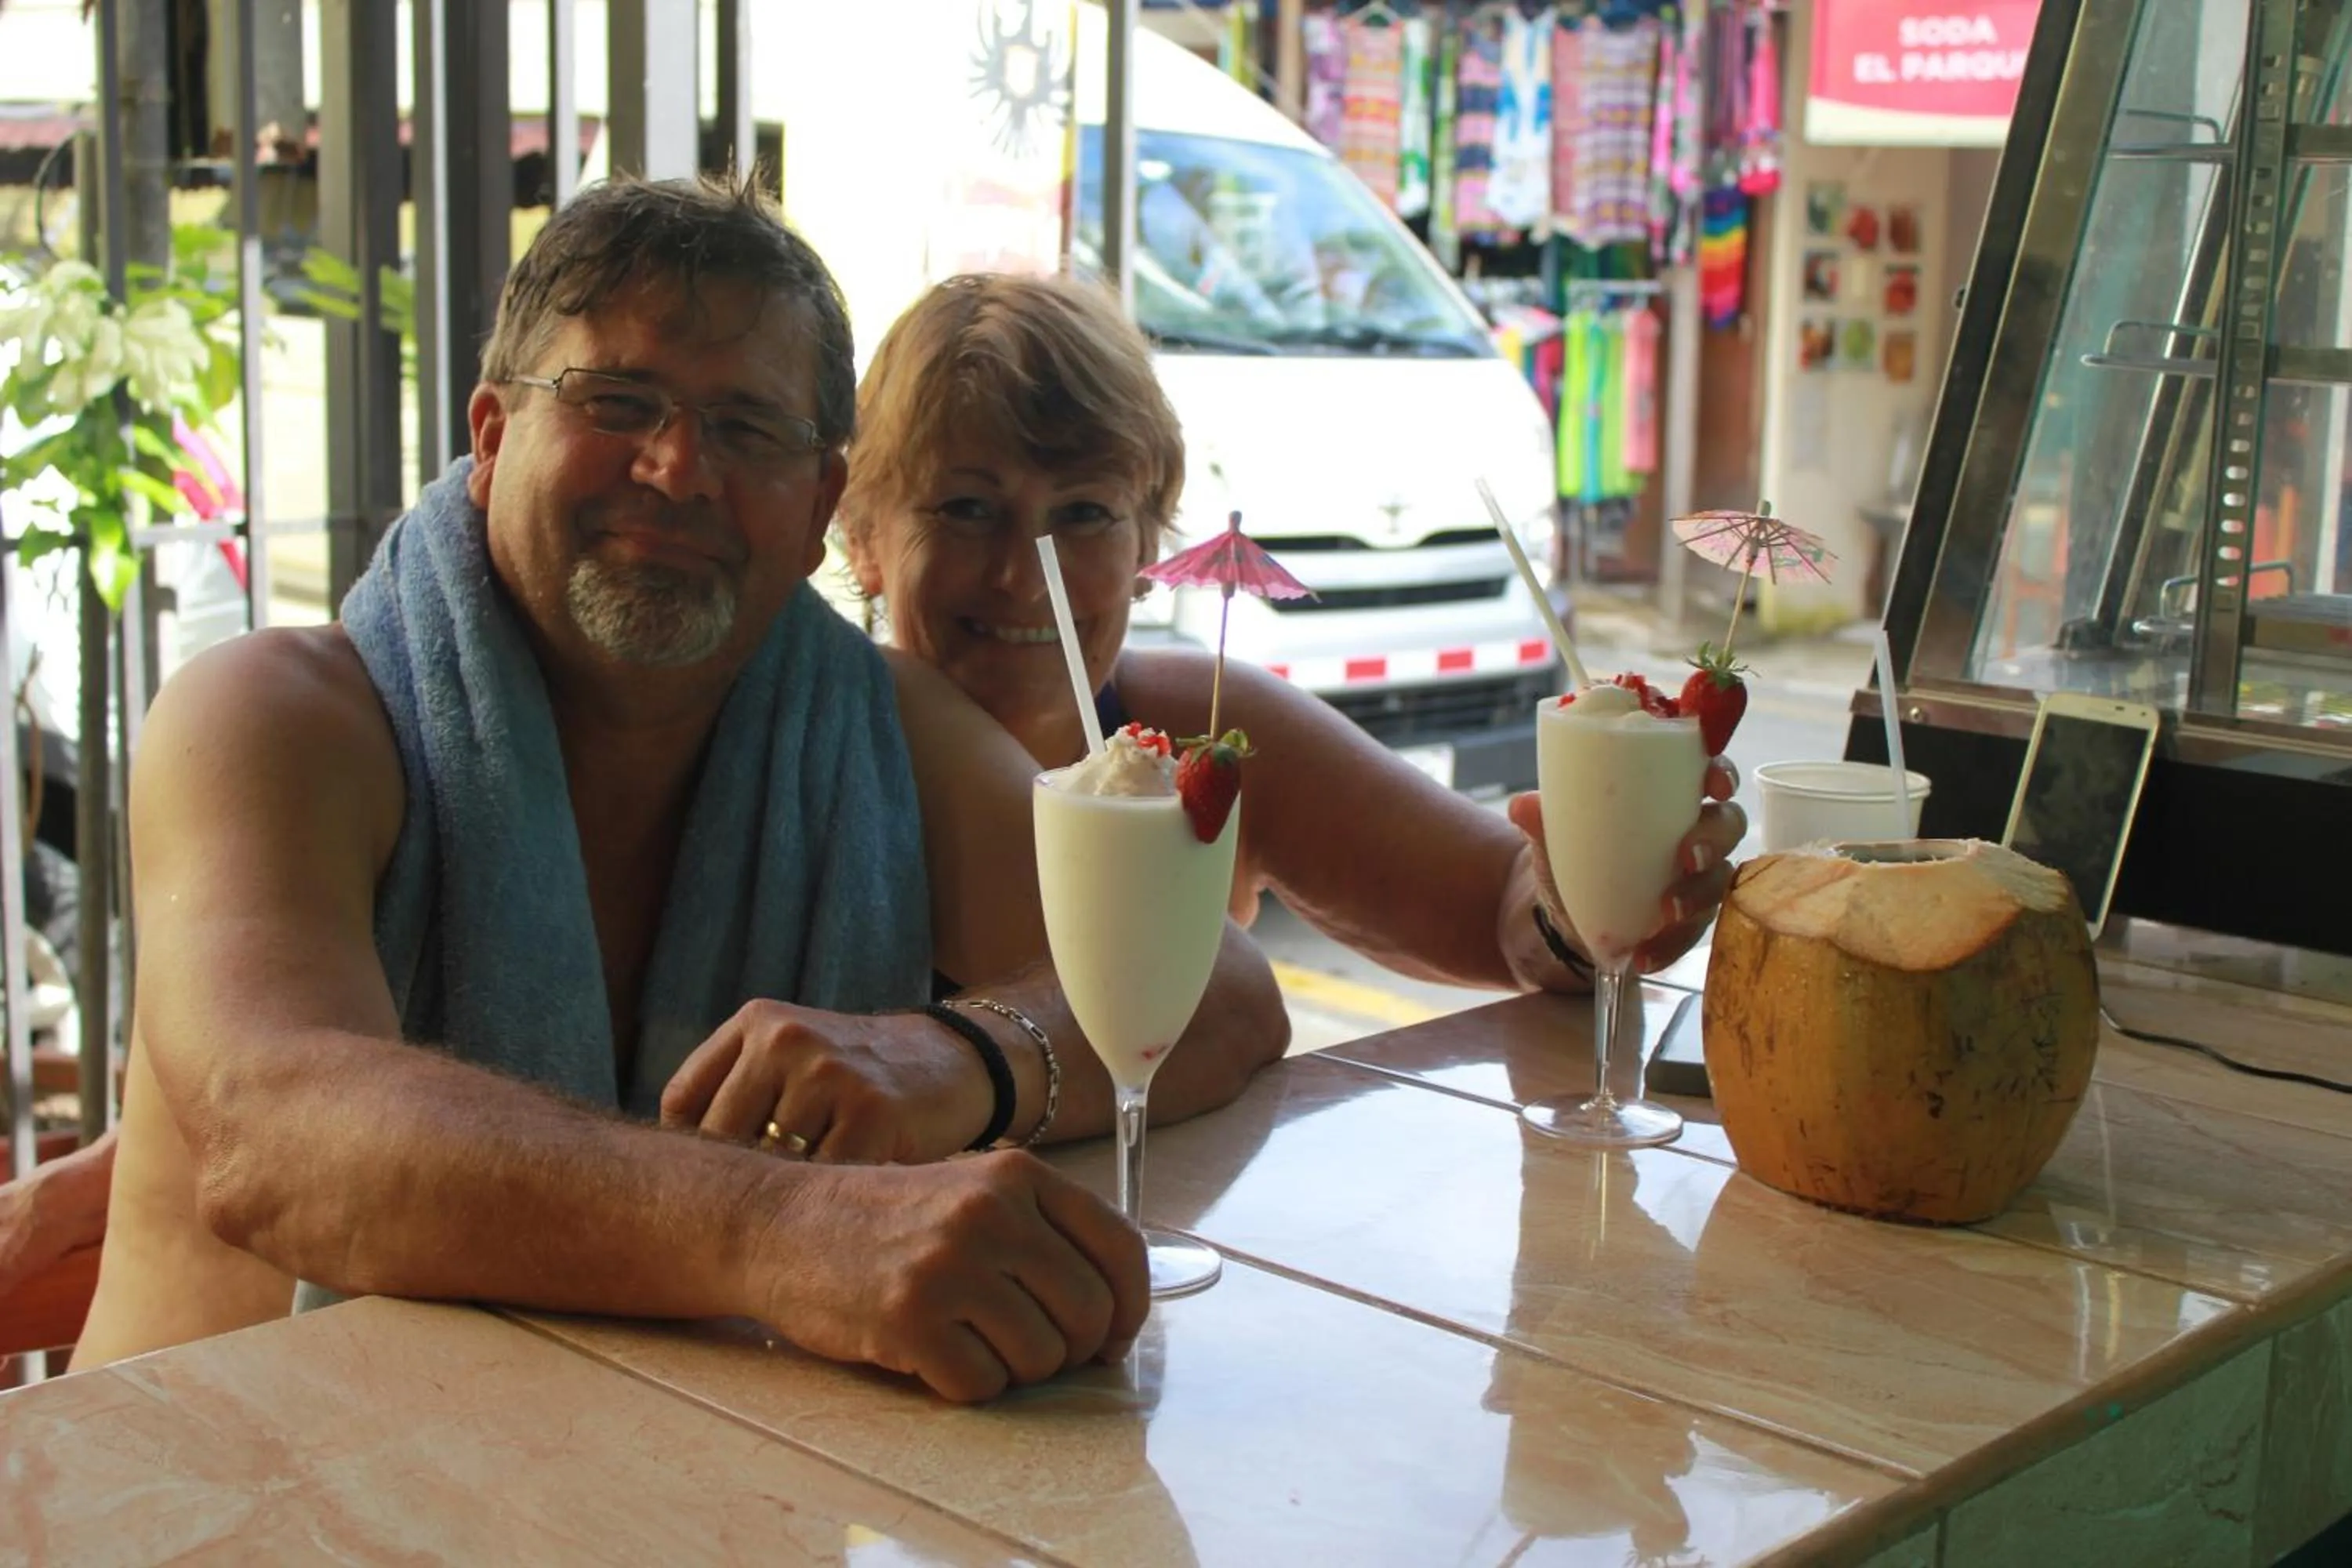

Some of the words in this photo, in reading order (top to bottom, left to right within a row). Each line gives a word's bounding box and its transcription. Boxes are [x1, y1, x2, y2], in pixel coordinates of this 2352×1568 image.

[1899, 16, 1998, 46] SODA
[1853, 53, 1896, 82] EL
[1900, 50, 2027, 82] PARQU
